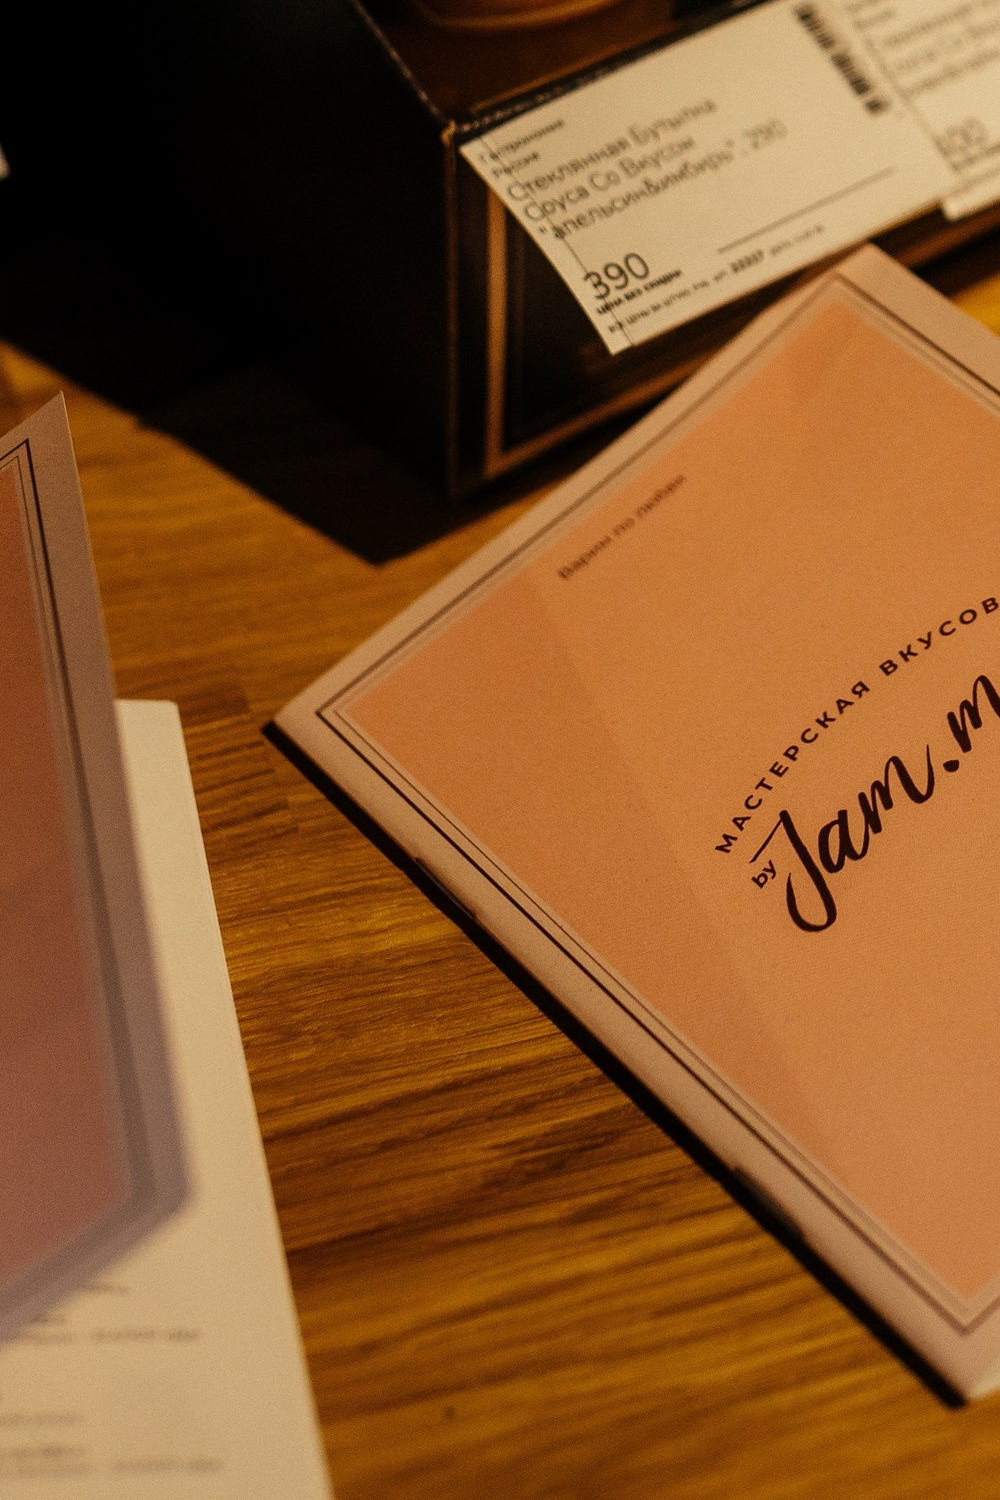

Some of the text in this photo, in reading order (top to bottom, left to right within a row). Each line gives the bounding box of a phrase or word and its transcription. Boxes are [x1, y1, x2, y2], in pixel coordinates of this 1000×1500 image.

[507, 98, 718, 201] Стеклянная Бутылка
[524, 135, 695, 222] Соуса Со Вкусом
[583, 252, 650, 301] 390
[596, 297, 624, 316] ЦЕНА
[624, 288, 643, 303] БЕЗ
[714, 596, 999, 854] МАСТЕРСКАЯ ВКУСОВ
[750, 859, 777, 889] by
